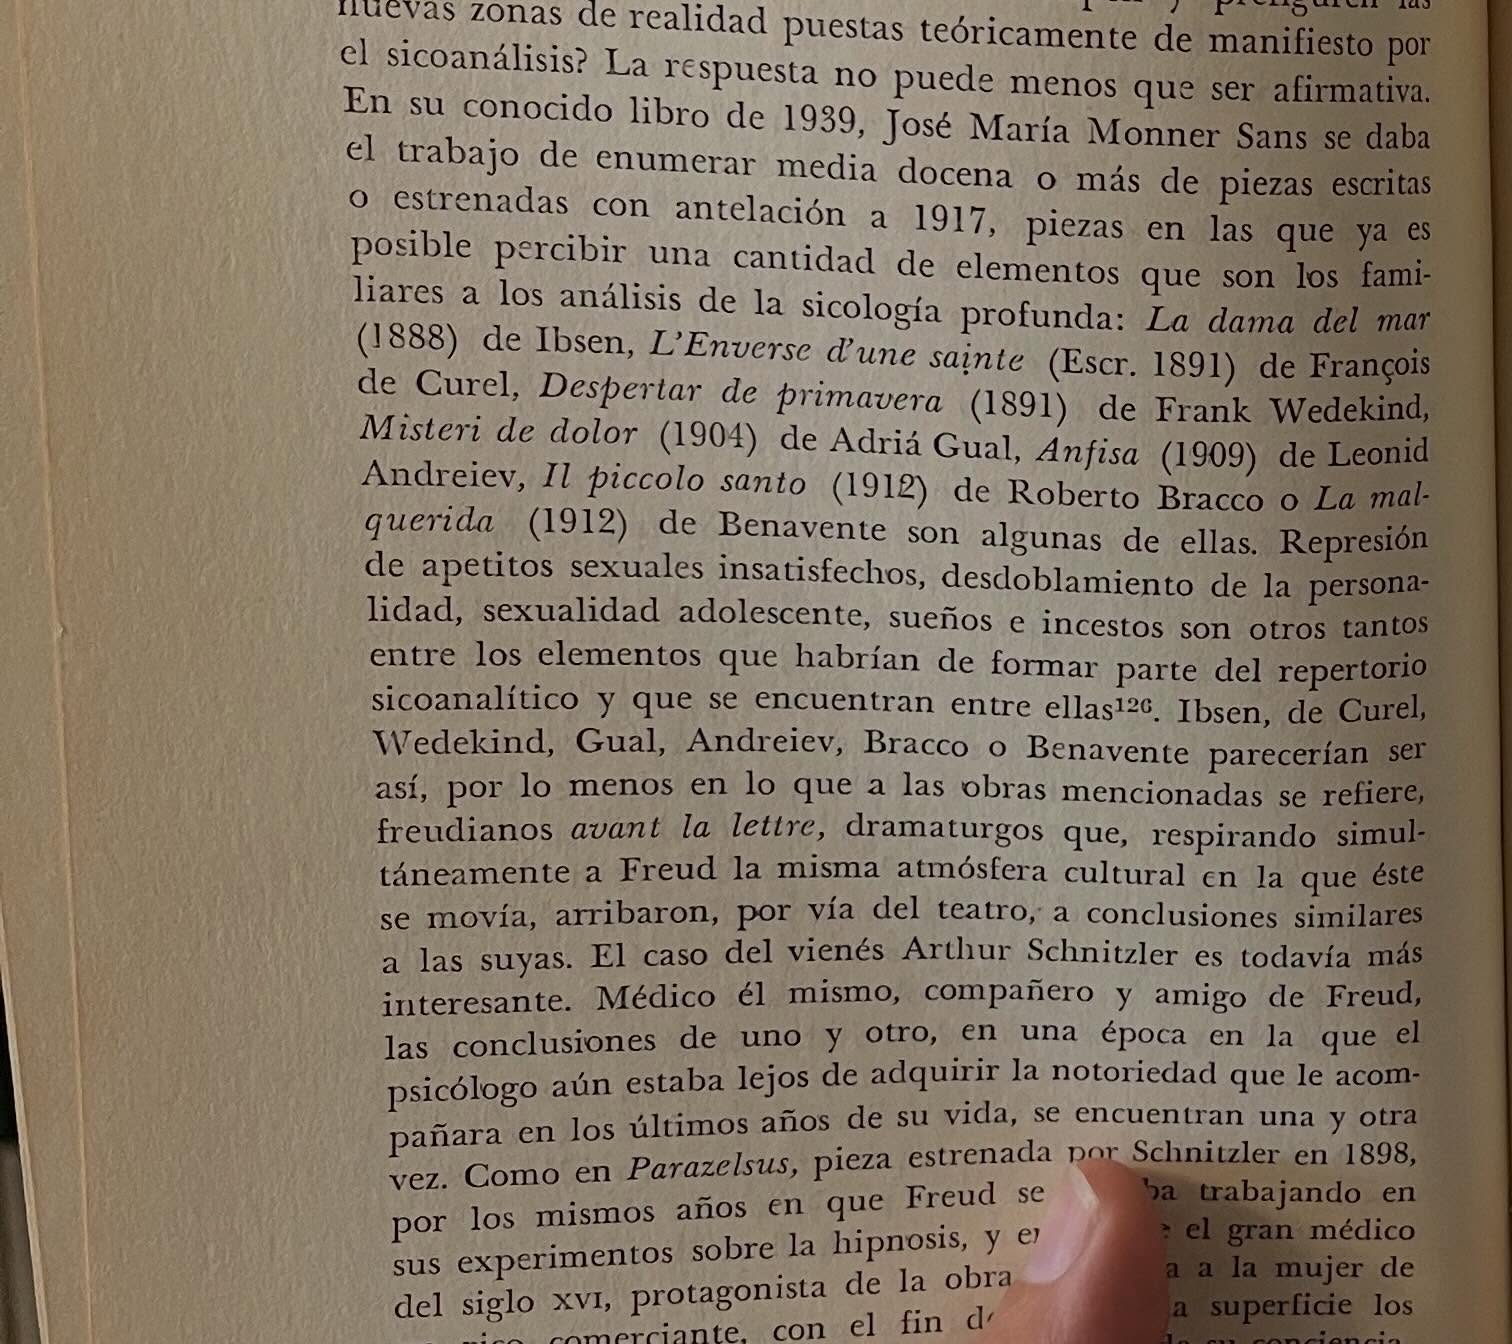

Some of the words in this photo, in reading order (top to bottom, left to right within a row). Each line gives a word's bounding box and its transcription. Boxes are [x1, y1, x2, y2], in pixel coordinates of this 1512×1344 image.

[359, 412, 482, 443] Misteri
[496, 415, 535, 444] de
[550, 416, 639, 445] dolor
[659, 419, 757, 458] (1904)
[780, 423, 817, 452] de
[828, 426, 923, 457] Adriá
[933, 431, 1021, 465] Gual,
[1034, 436, 1140, 472] Anfisa
[1161, 440, 1257, 478] (1909)
[1279, 441, 1316, 469] de
[1327, 435, 1429, 467] Leonid
[371, 683, 579, 712] sicoanalítico
[596, 691, 616, 719] y
[632, 691, 693, 720] que
[709, 691, 738, 710] se
[754, 691, 935, 714] encuentran
[950, 696, 1032, 718] entre
[1176, 698, 1271, 729] Ibsen,
[1287, 698, 1324, 725] de
[1338, 692, 1426, 723] Curel,
[381, 991, 572, 1018] interesante.
[595, 982, 716, 1011] Médico
[738, 980, 766, 1007] él
[787, 978, 900, 1006] mismo,
[924, 978, 1094, 1010] compañero
[1115, 987, 1133, 1012] y
[1154, 982, 1247, 1015] amigo
[1268, 983, 1305, 1008] de
[1325, 979, 1422, 1008] Freud,
[388, 1172, 448, 1192] vez.
[464, 1162, 560, 1189] Como
[575, 1165, 612, 1184] en
[625, 1151, 798, 1181] Parazelsus,
[813, 1145, 893, 1183] pieza
[908, 1138, 1053, 1169] estrenada
[1132, 1139, 1281, 1165] Schnitzler
[1294, 1148, 1329, 1166] en
[1345, 1140, 1416, 1168] 1898,
